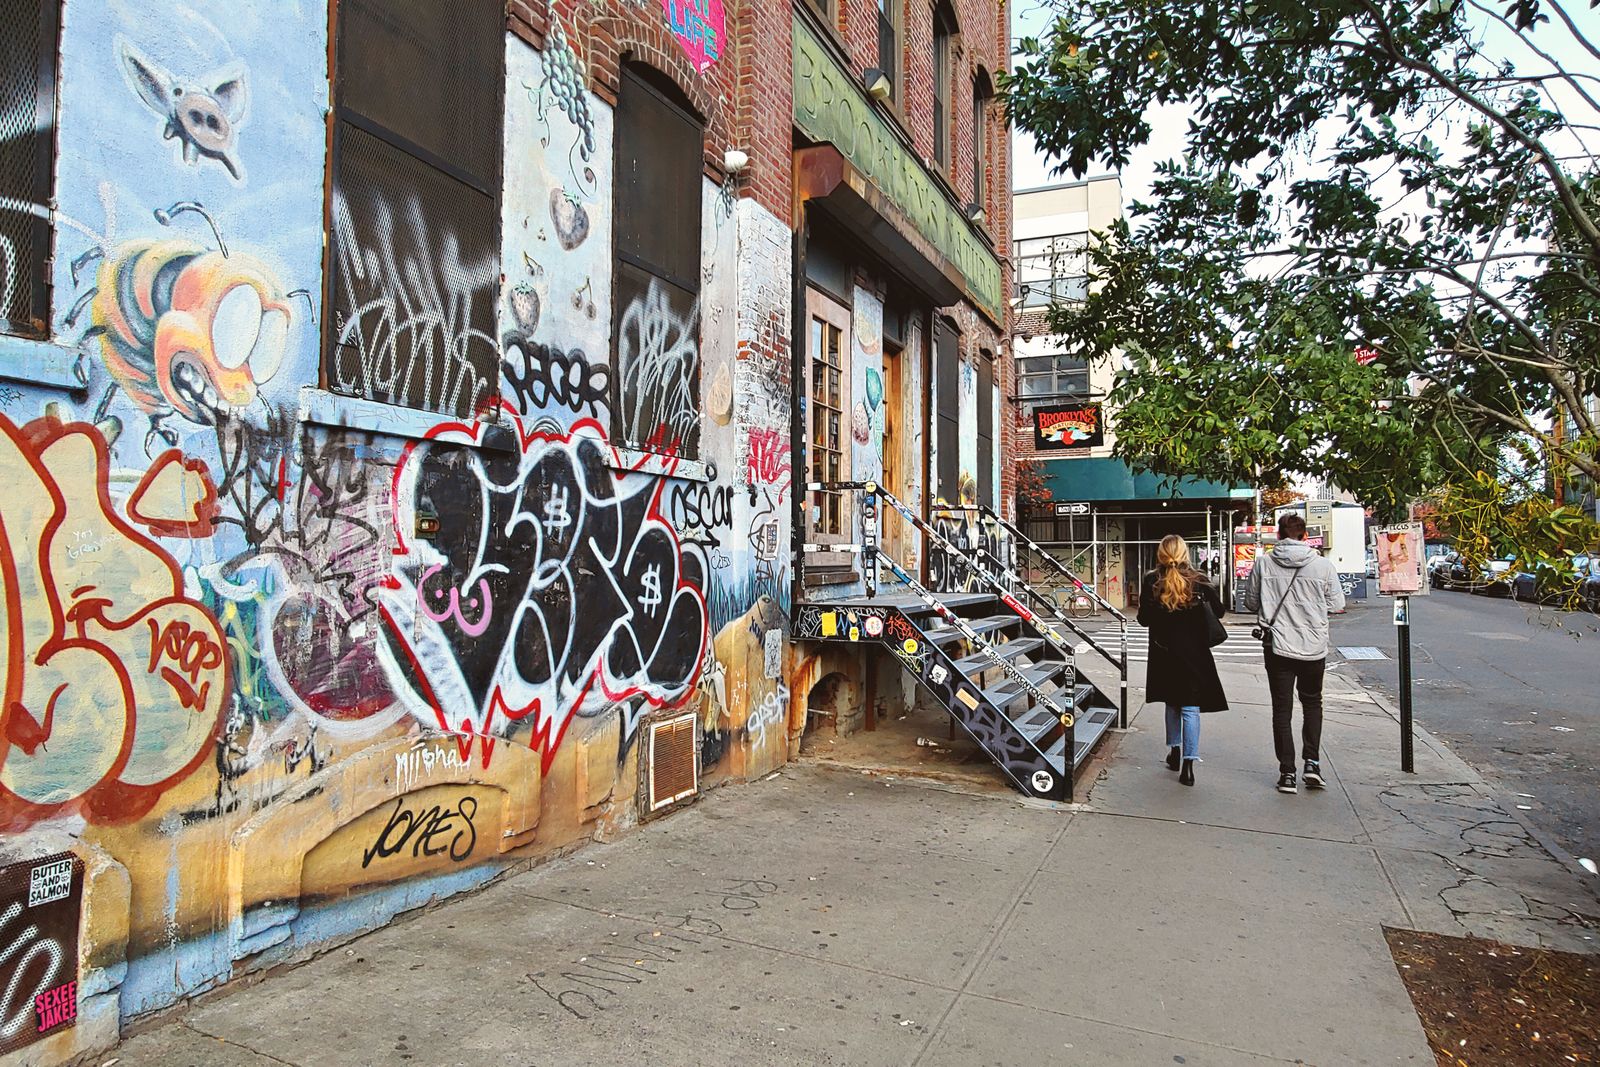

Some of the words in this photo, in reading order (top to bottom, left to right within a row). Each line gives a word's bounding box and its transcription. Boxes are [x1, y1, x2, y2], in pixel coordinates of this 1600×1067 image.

[669, 0, 718, 60] LIFE
[32, 860, 72, 881] BUTTER
[42, 875, 60, 888] AND
[30, 882, 70, 903] SALMON
[35, 981, 77, 1014] SEXEE
[38, 1001, 77, 1032] JAKEE
